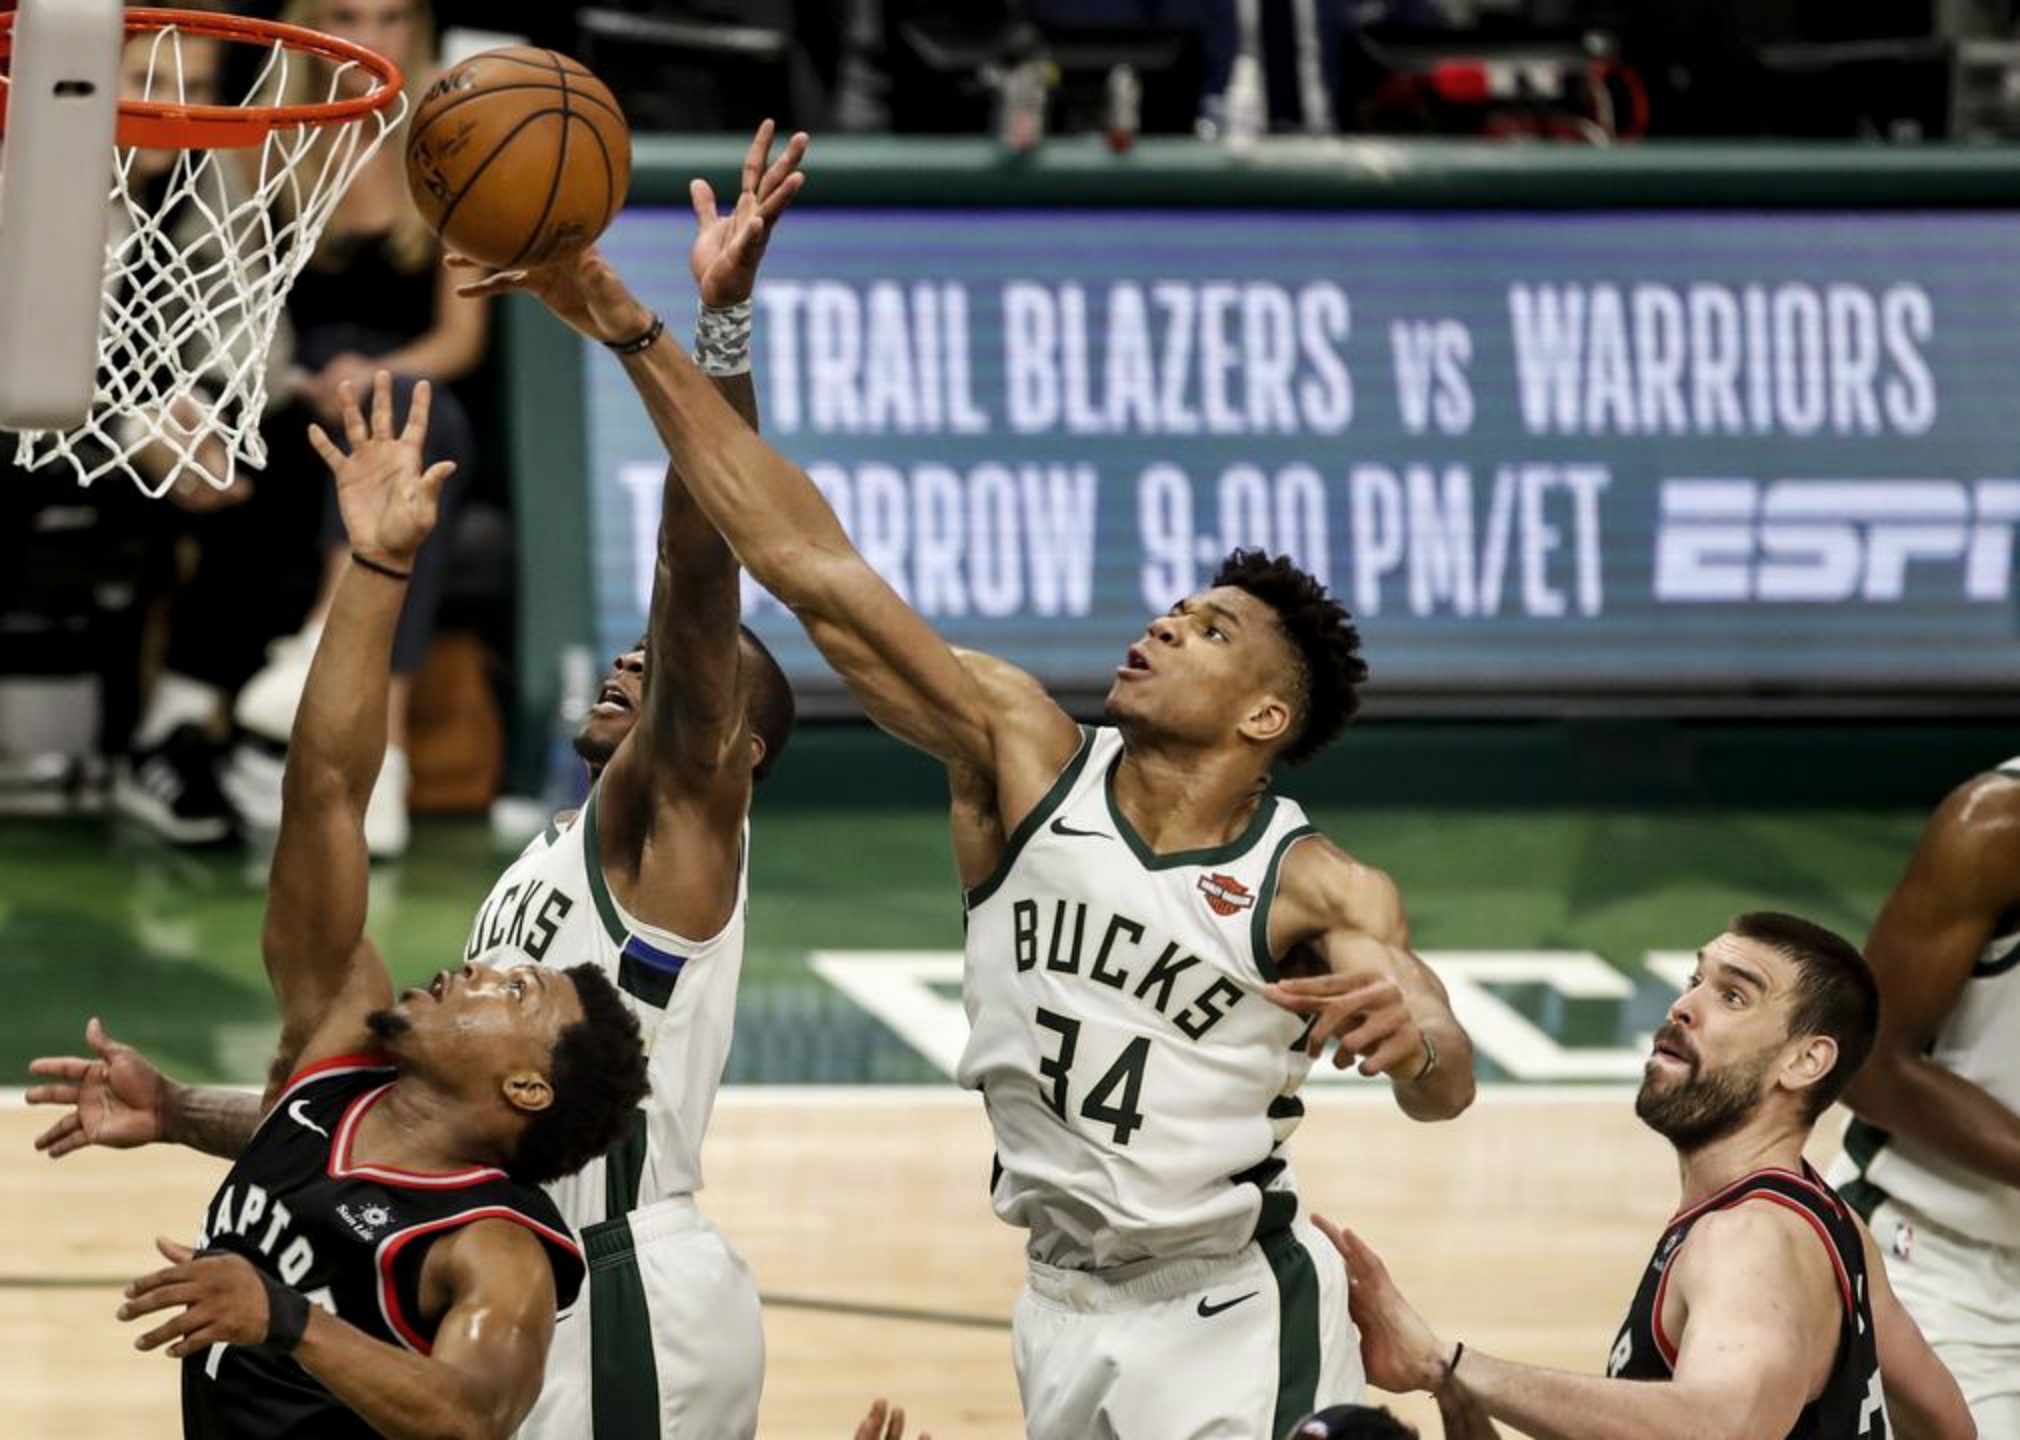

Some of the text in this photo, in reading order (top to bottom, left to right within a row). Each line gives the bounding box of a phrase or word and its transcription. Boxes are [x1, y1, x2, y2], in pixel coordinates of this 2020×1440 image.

[760, 280, 989, 434] TRAIL
[1006, 280, 1354, 435] BLAZERS
[1508, 281, 1937, 435] WARRIORS
[617, 461, 1098, 616] TRROW
[1350, 462, 1610, 617] PM/ET
[467, 880, 574, 962] UCKS
[1013, 898, 1245, 1041] BUCKS
[1036, 1007, 1152, 1146] 34
[194, 1184, 338, 1316] APTO
